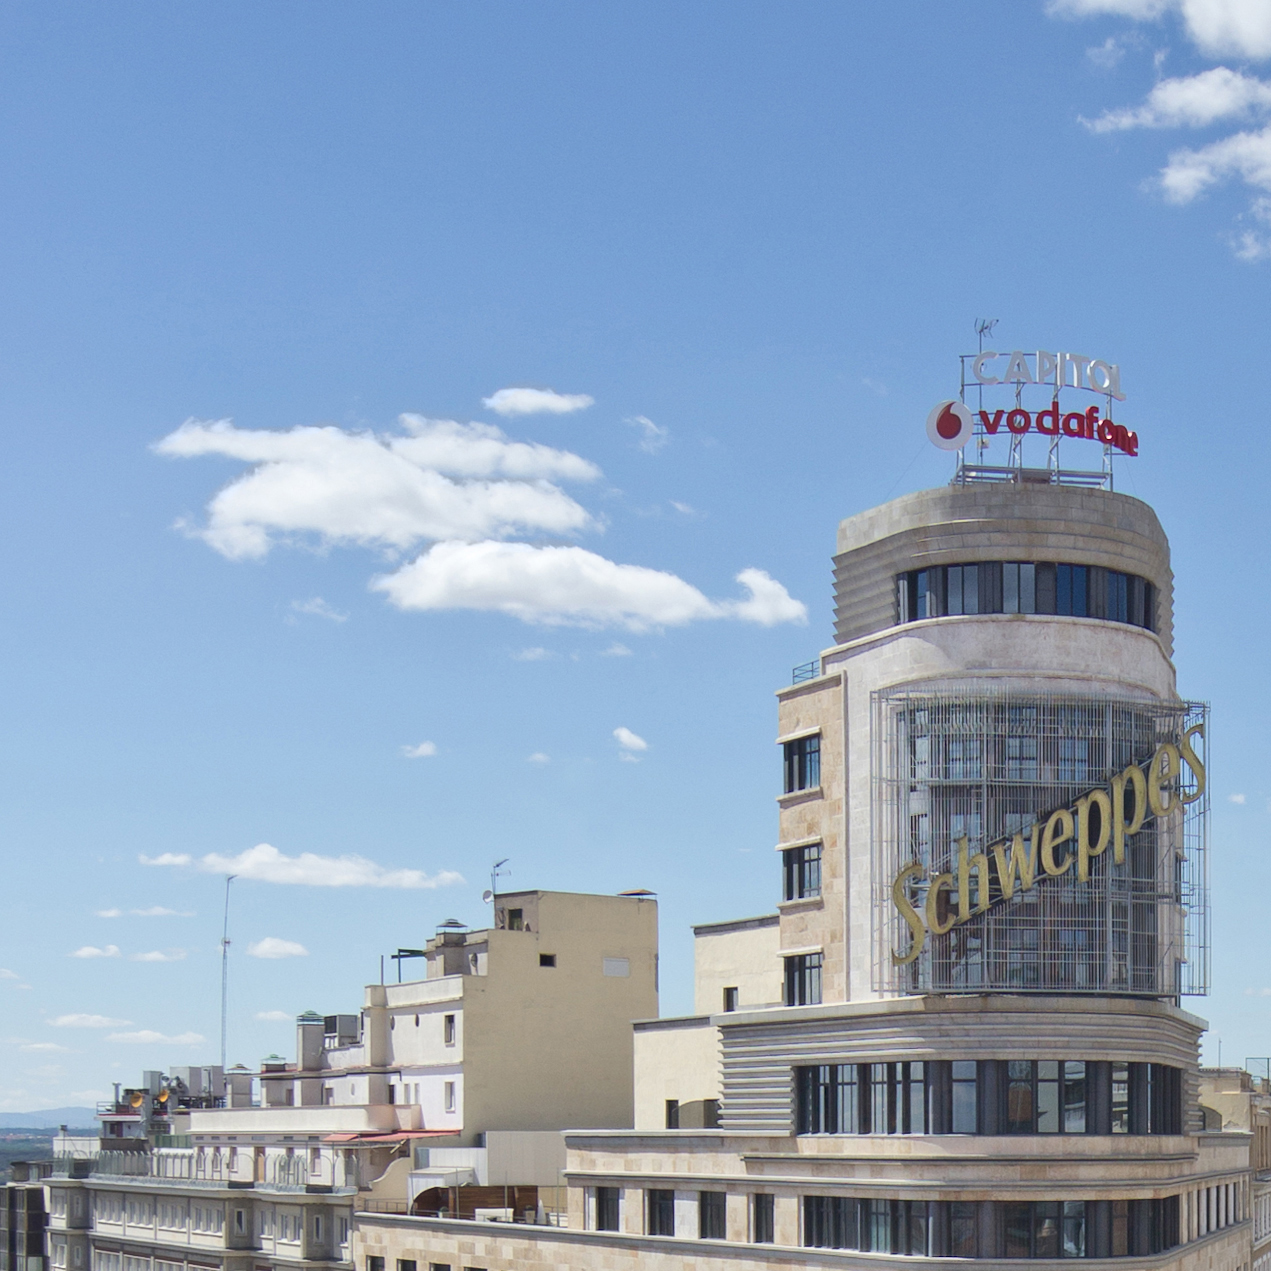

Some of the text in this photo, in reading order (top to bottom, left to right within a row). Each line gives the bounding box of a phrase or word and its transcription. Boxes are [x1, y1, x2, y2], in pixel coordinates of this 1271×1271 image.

[972, 350, 1126, 401] CAPITOL
[979, 400, 1138, 457] vodafone
[892, 723, 1206, 966] Schweppes
